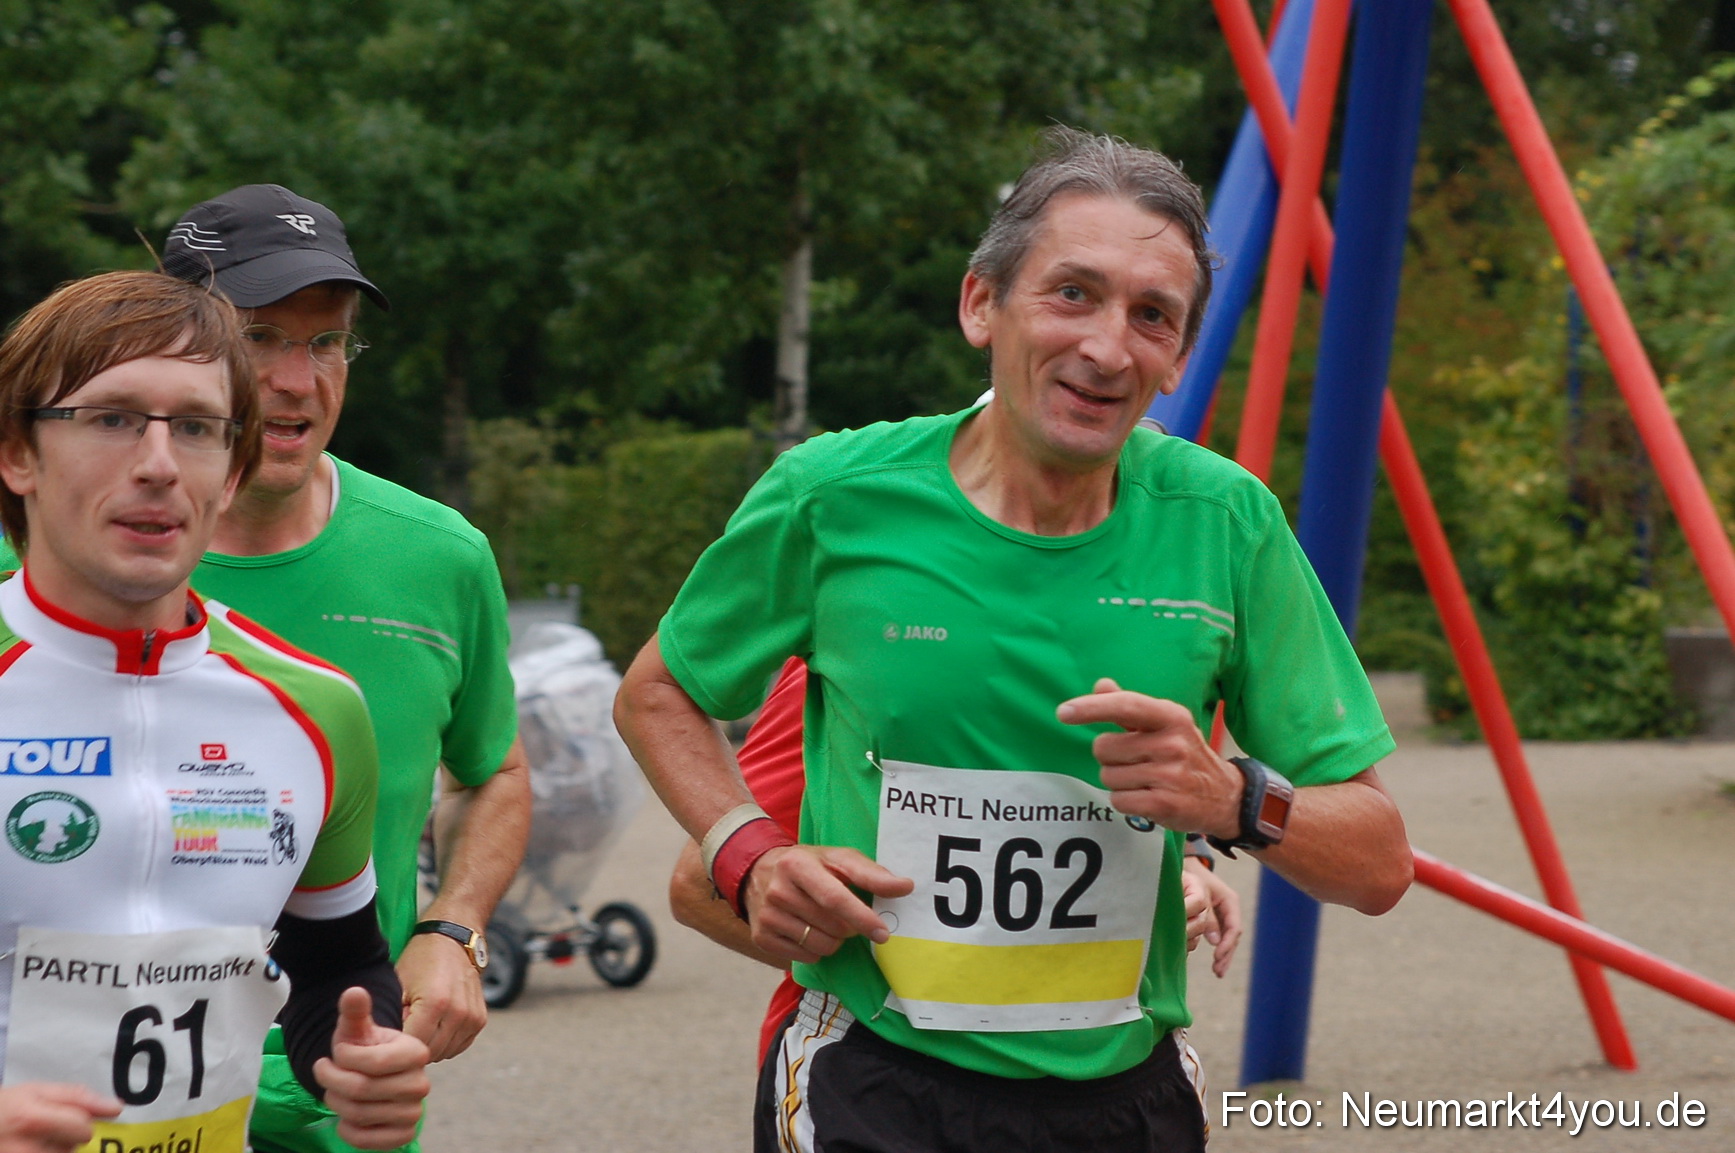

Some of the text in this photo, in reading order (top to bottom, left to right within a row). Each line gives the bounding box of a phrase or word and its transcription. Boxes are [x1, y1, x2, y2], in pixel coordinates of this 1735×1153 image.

[903, 625, 948, 642] JAKO
[886, 787, 1113, 822] PARTL Neumarkt
[933, 834, 1104, 932] 562
[22, 955, 256, 988] PARTL Neumarkt
[112, 998, 210, 1107] 61
